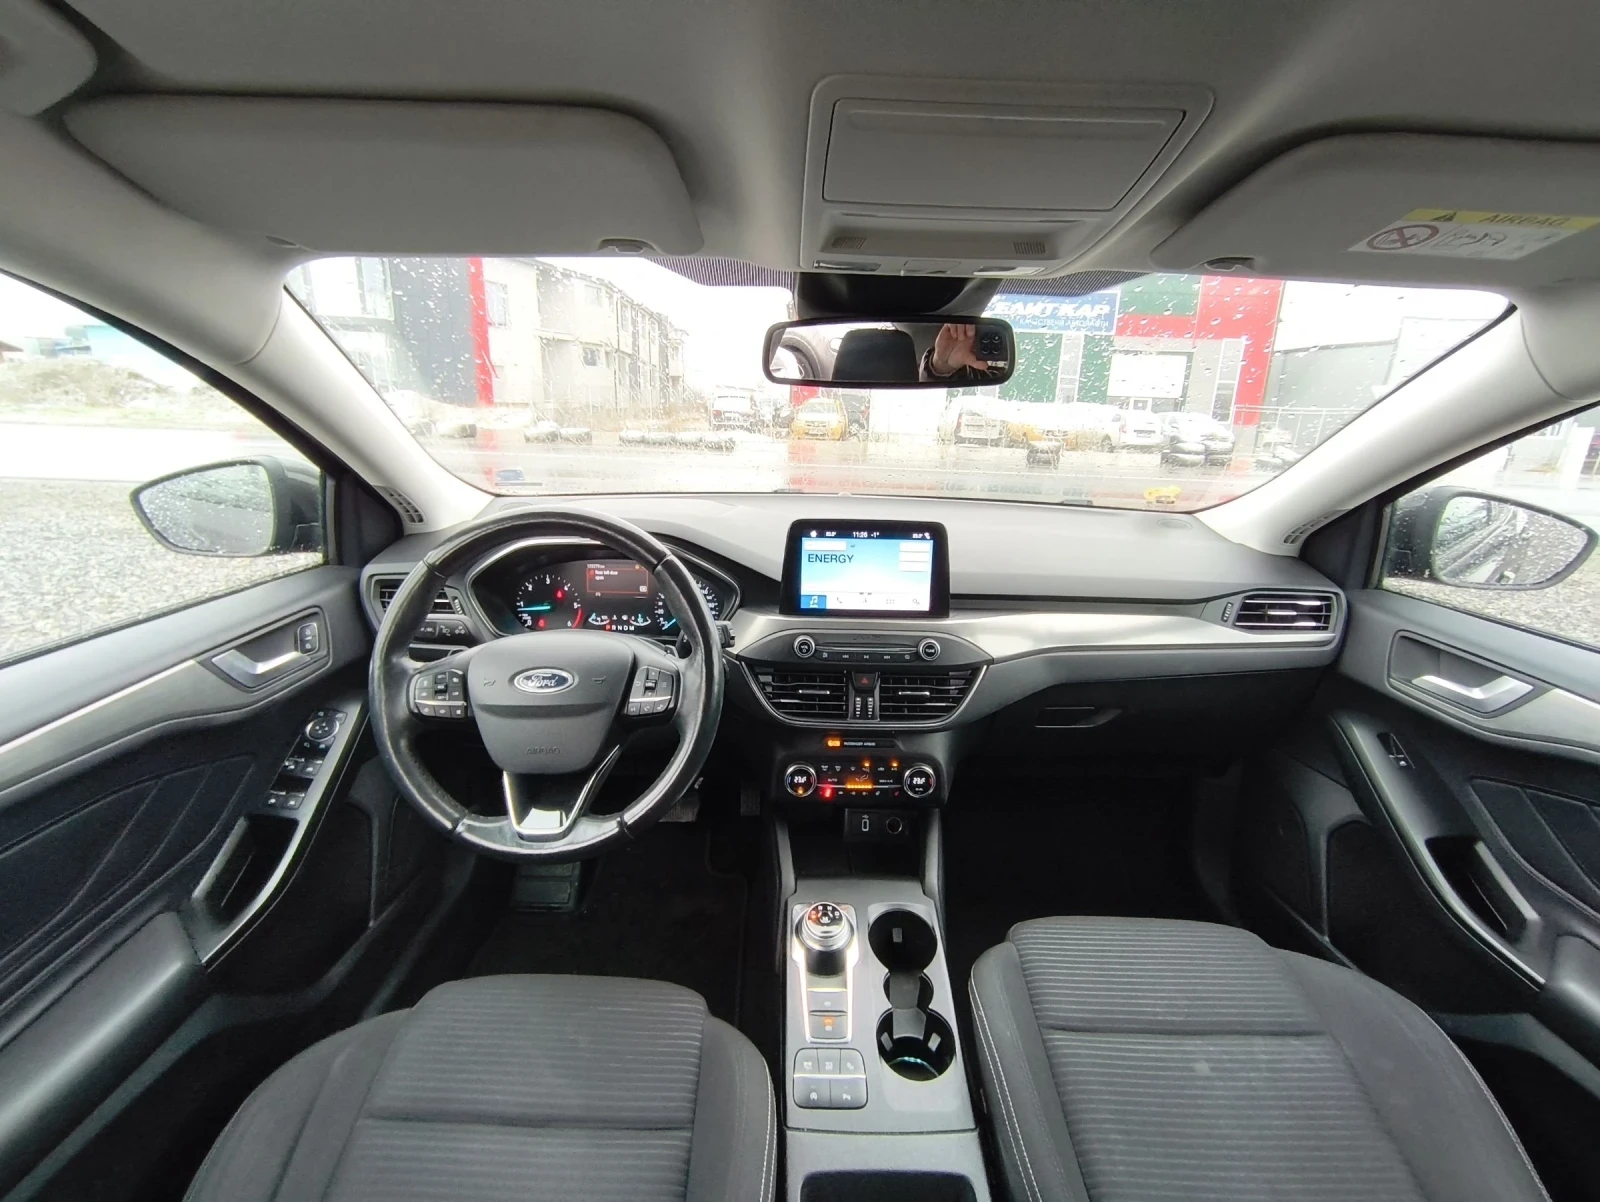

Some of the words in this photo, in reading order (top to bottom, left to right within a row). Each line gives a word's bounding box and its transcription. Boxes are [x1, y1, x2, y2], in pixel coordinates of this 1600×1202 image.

[1479, 213, 1571, 226] AIRBAG
[1058, 303, 1111, 318] КАР
[808, 554, 854, 563] ENERGY
[527, 673, 558, 687] Ford
[525, 746, 561, 755] AIRBAG
